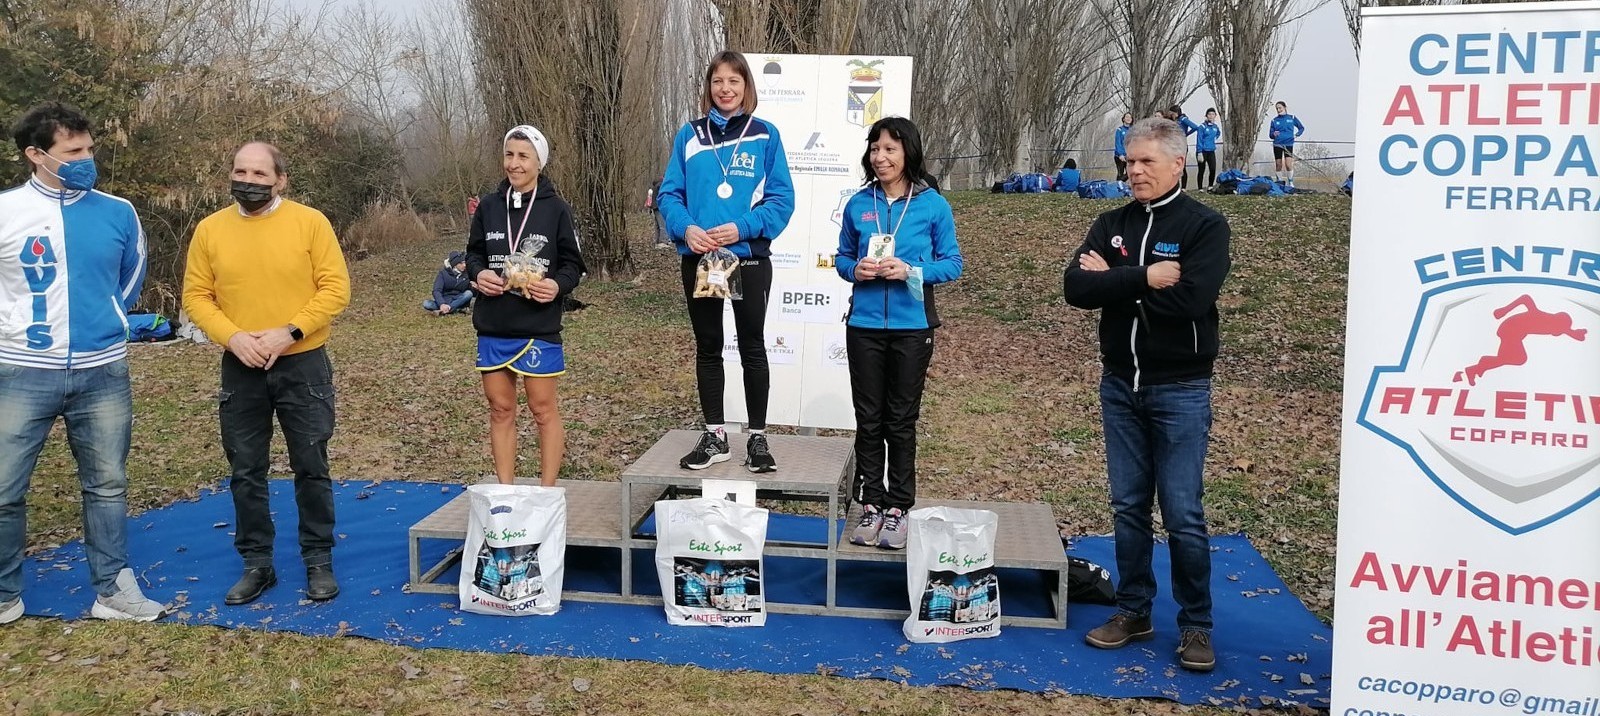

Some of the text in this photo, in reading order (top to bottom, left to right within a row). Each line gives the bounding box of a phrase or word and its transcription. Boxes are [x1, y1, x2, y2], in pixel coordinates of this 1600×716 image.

[1378, 133, 1599, 177] COPPA
[19, 235, 58, 351] AVIS
[782, 306, 801, 314] Banca
[1450, 426, 1588, 449] COPPARO
[502, 527, 527, 542] Sport
[714, 540, 743, 555] Sport
[692, 613, 752, 623] INTERSPORT
[935, 622, 993, 636] INTERSPORT
